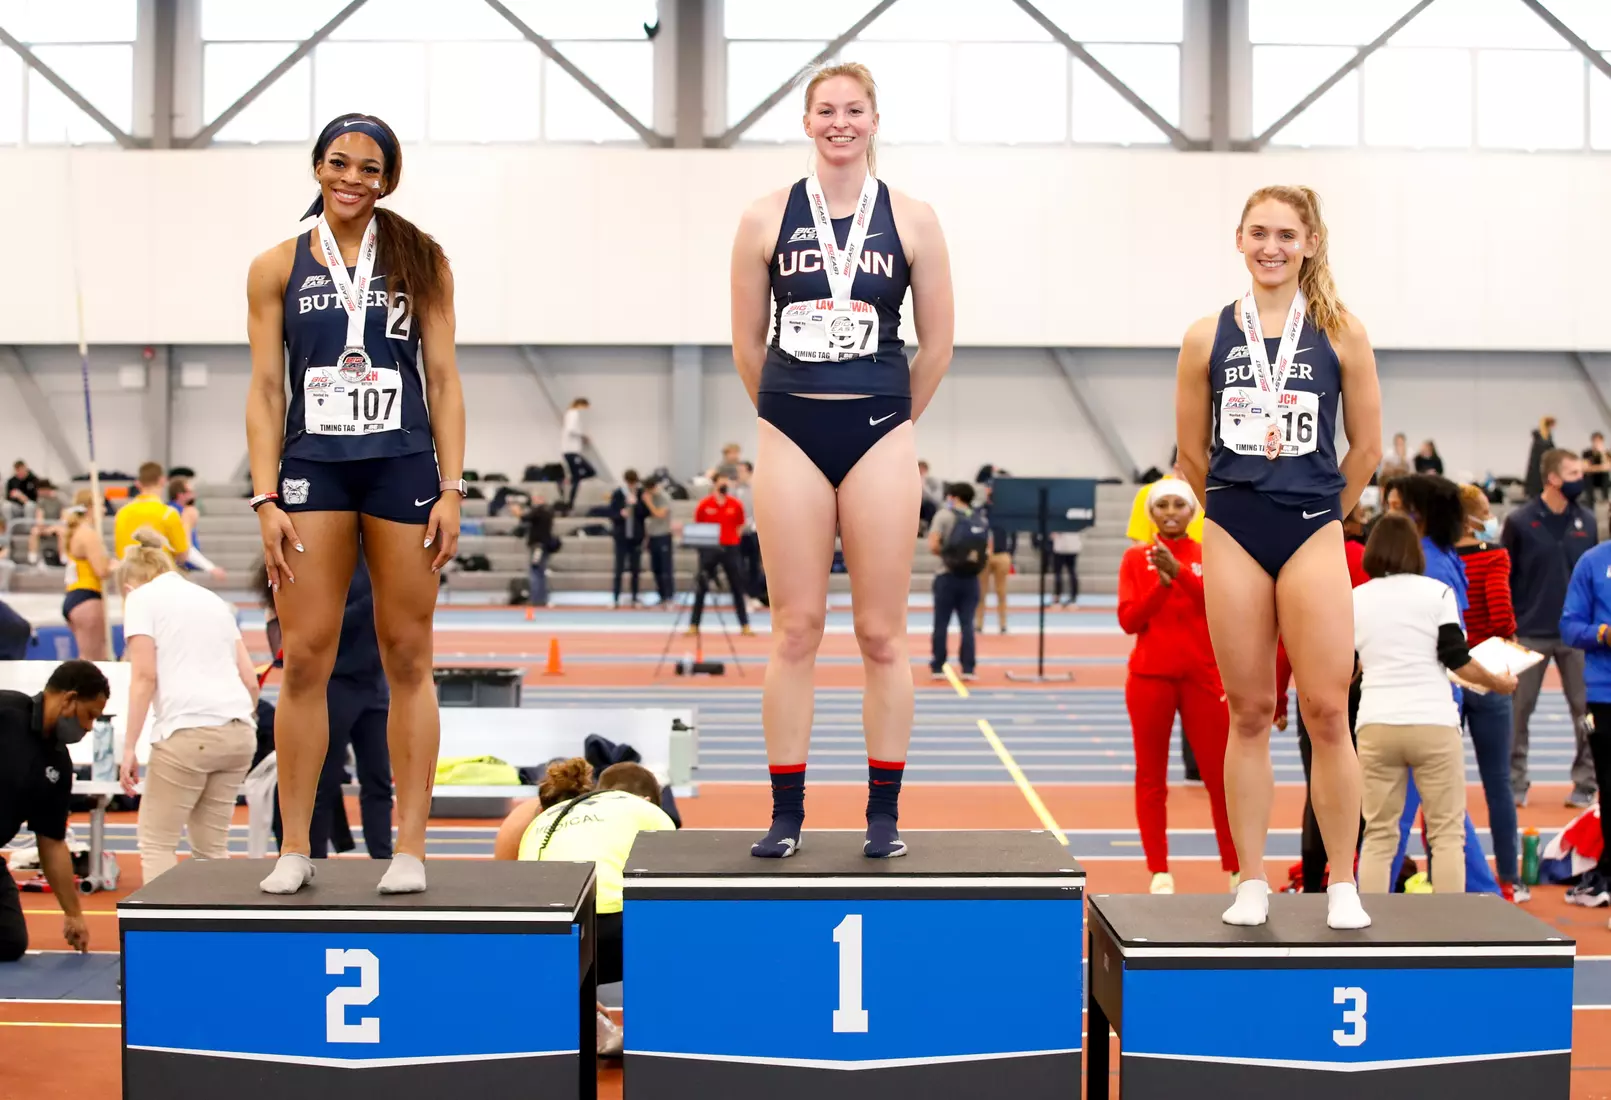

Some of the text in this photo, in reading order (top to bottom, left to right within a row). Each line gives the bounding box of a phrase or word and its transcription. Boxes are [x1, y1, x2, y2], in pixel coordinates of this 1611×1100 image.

[778, 249, 894, 278] UCNN
[298, 290, 389, 314] BUTER
[390, 295, 410, 337] 2
[794, 350, 817, 359] TIMING
[818, 351, 831, 359] TAG
[1224, 362, 1314, 385] BUER
[347, 388, 398, 421] 107
[320, 424, 342, 432] TIMING
[343, 424, 356, 432] TAG
[1279, 411, 1313, 443] 16
[1235, 443, 1258, 452] TIMING
[832, 914, 869, 1033] 1
[325, 948, 380, 1044] 2
[1332, 986, 1368, 1047] 3
